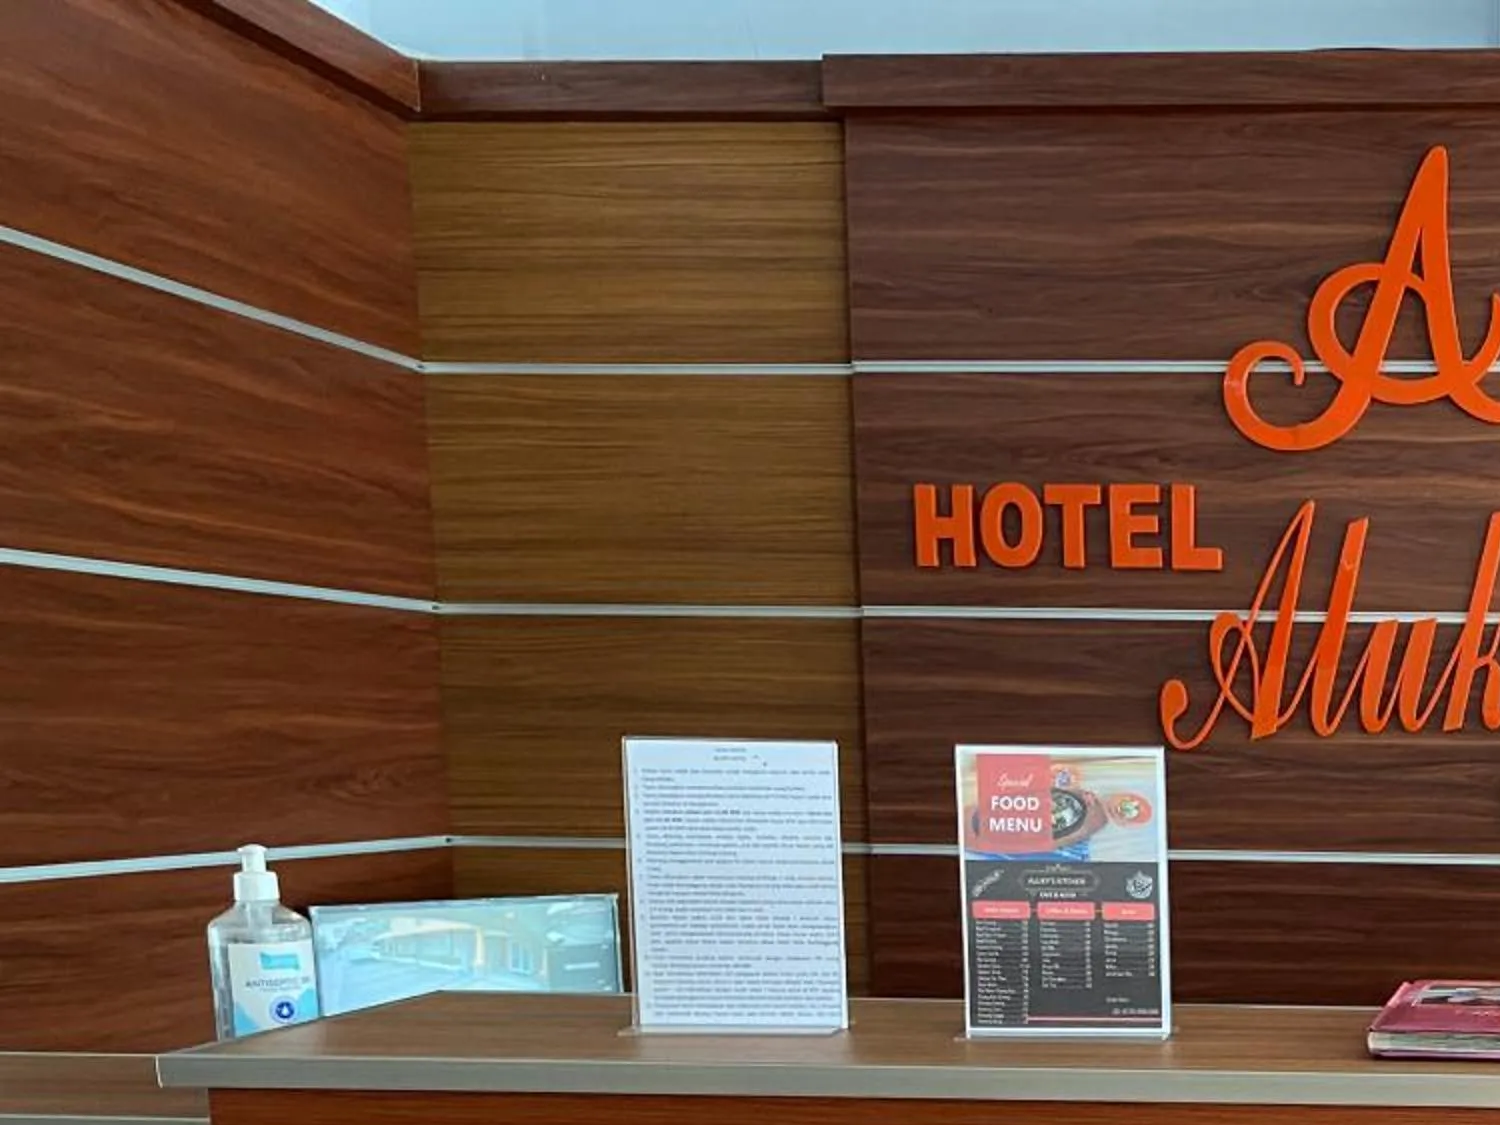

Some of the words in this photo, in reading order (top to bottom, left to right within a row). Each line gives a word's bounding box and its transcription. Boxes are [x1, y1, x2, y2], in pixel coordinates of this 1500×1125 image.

[913, 483, 1223, 571] HOTEL
[991, 795, 1040, 811] FOOD
[989, 817, 1042, 832] MENU
